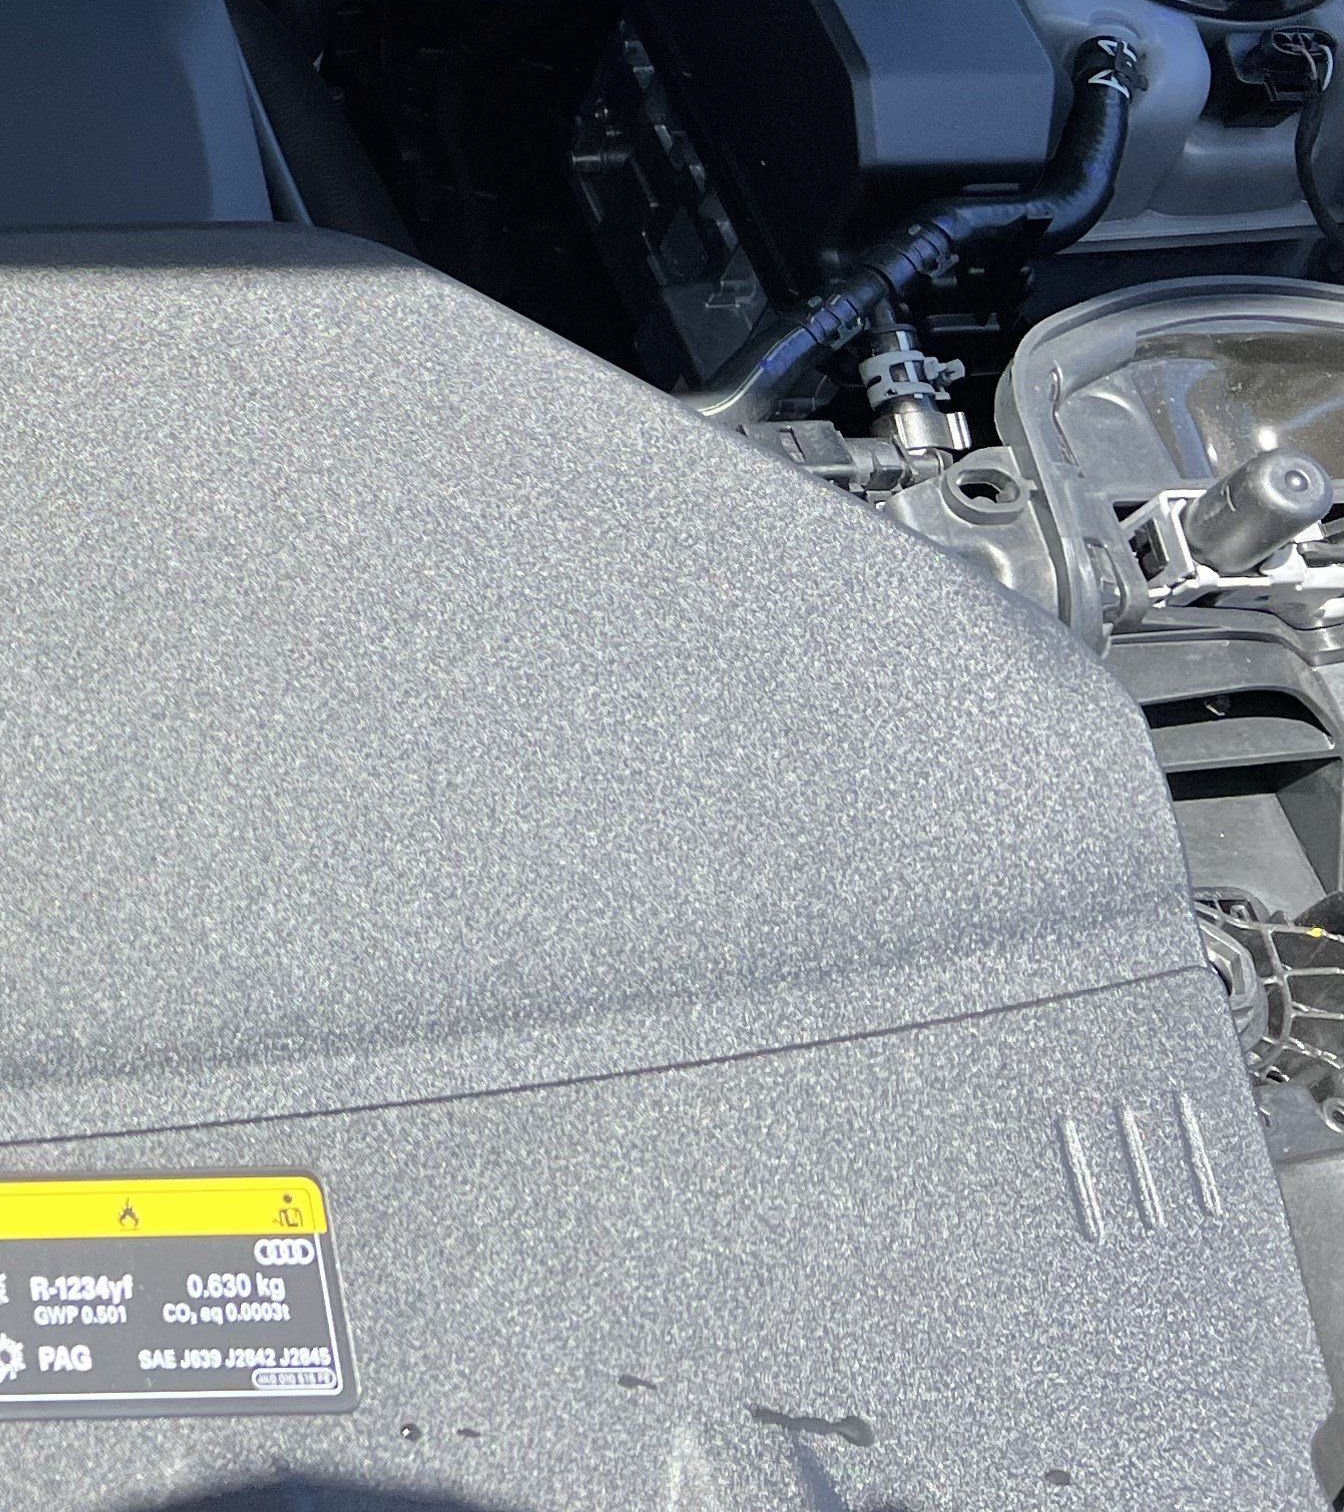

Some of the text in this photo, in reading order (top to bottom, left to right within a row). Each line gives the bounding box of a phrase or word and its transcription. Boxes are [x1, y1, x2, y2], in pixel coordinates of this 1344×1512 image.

[30, 1272, 286, 1305] R-1234yf 0.630 kg
[33, 1305, 127, 1326] GWP 0.501
[38, 1344, 332, 1372] PAG SAE J639 J2842 J2845
